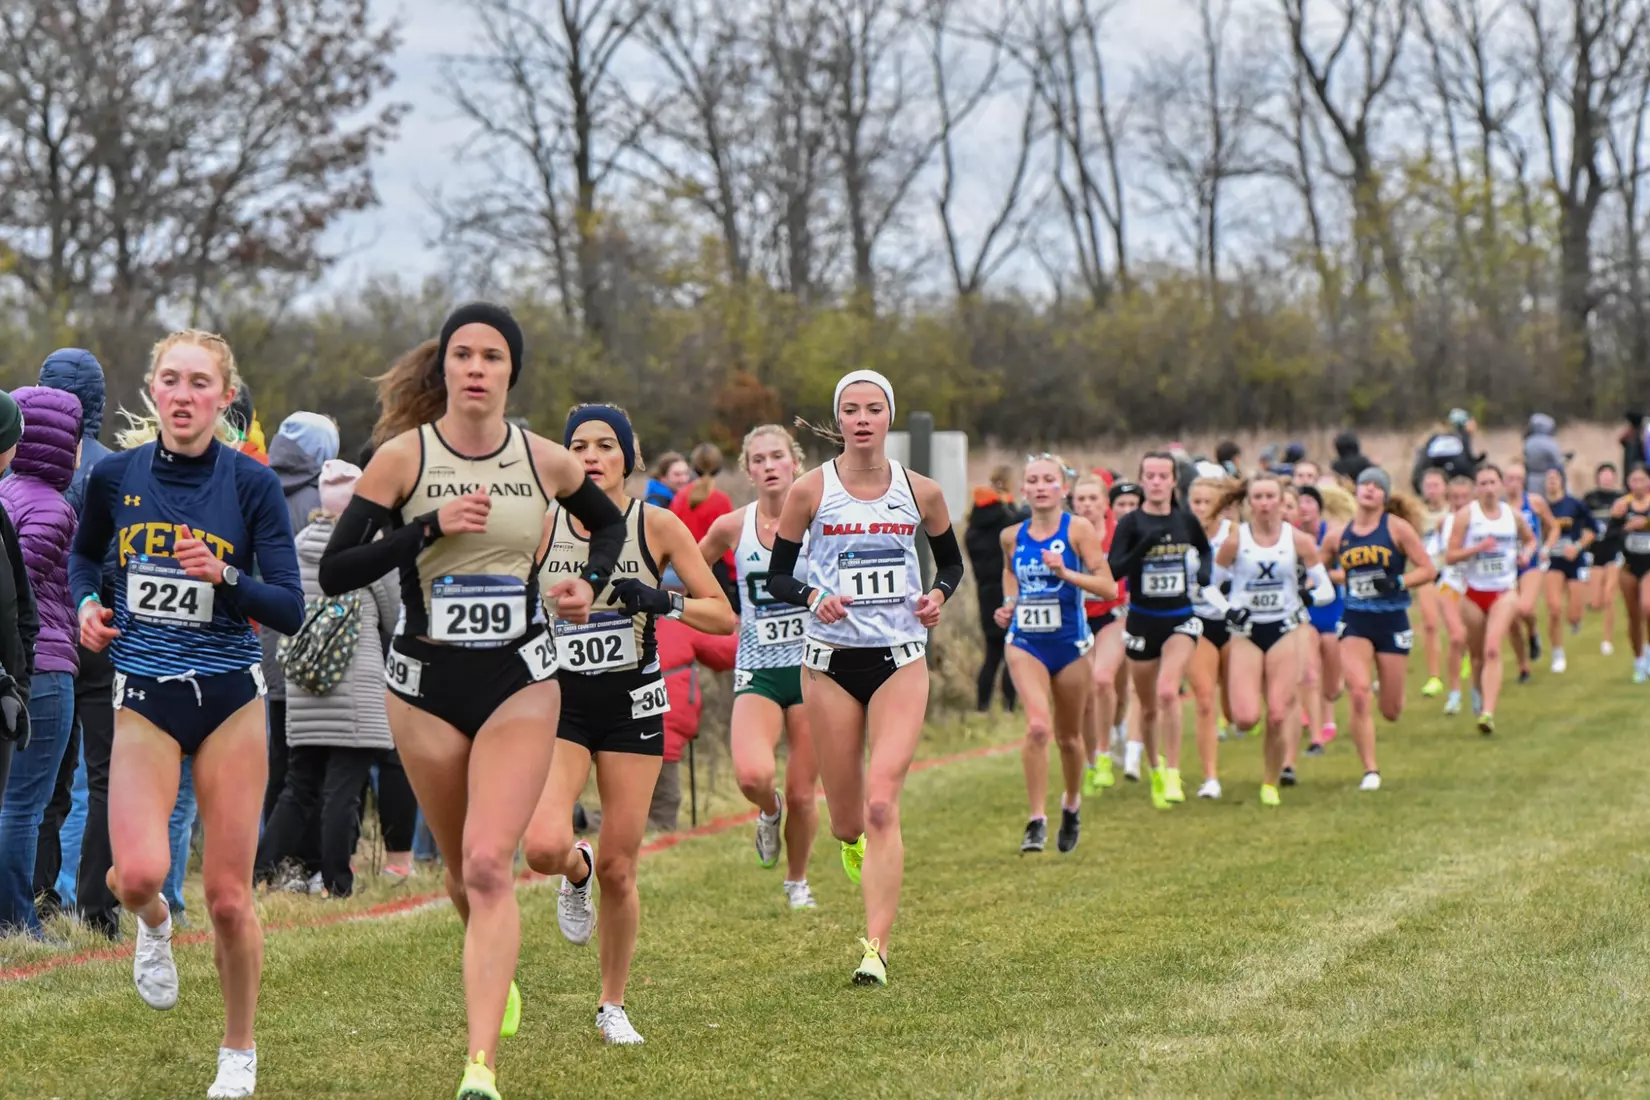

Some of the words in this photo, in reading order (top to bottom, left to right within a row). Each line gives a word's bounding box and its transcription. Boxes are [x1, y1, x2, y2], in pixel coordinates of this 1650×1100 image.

[823, 523, 865, 536] BALL
[548, 561, 640, 574] OAKND
[1340, 545, 1393, 569] KENT
[1257, 561, 1278, 580] X
[851, 570, 894, 595] 111
[1149, 575, 1178, 590] 337
[138, 581, 199, 615] 224
[1251, 593, 1279, 607] 402
[446, 603, 512, 635] 299
[577, 623, 597, 631] COUNTRY
[1023, 608, 1051, 625] 211
[765, 618, 804, 641] 373
[568, 635, 624, 667] 302
[641, 685, 667, 711] 30
